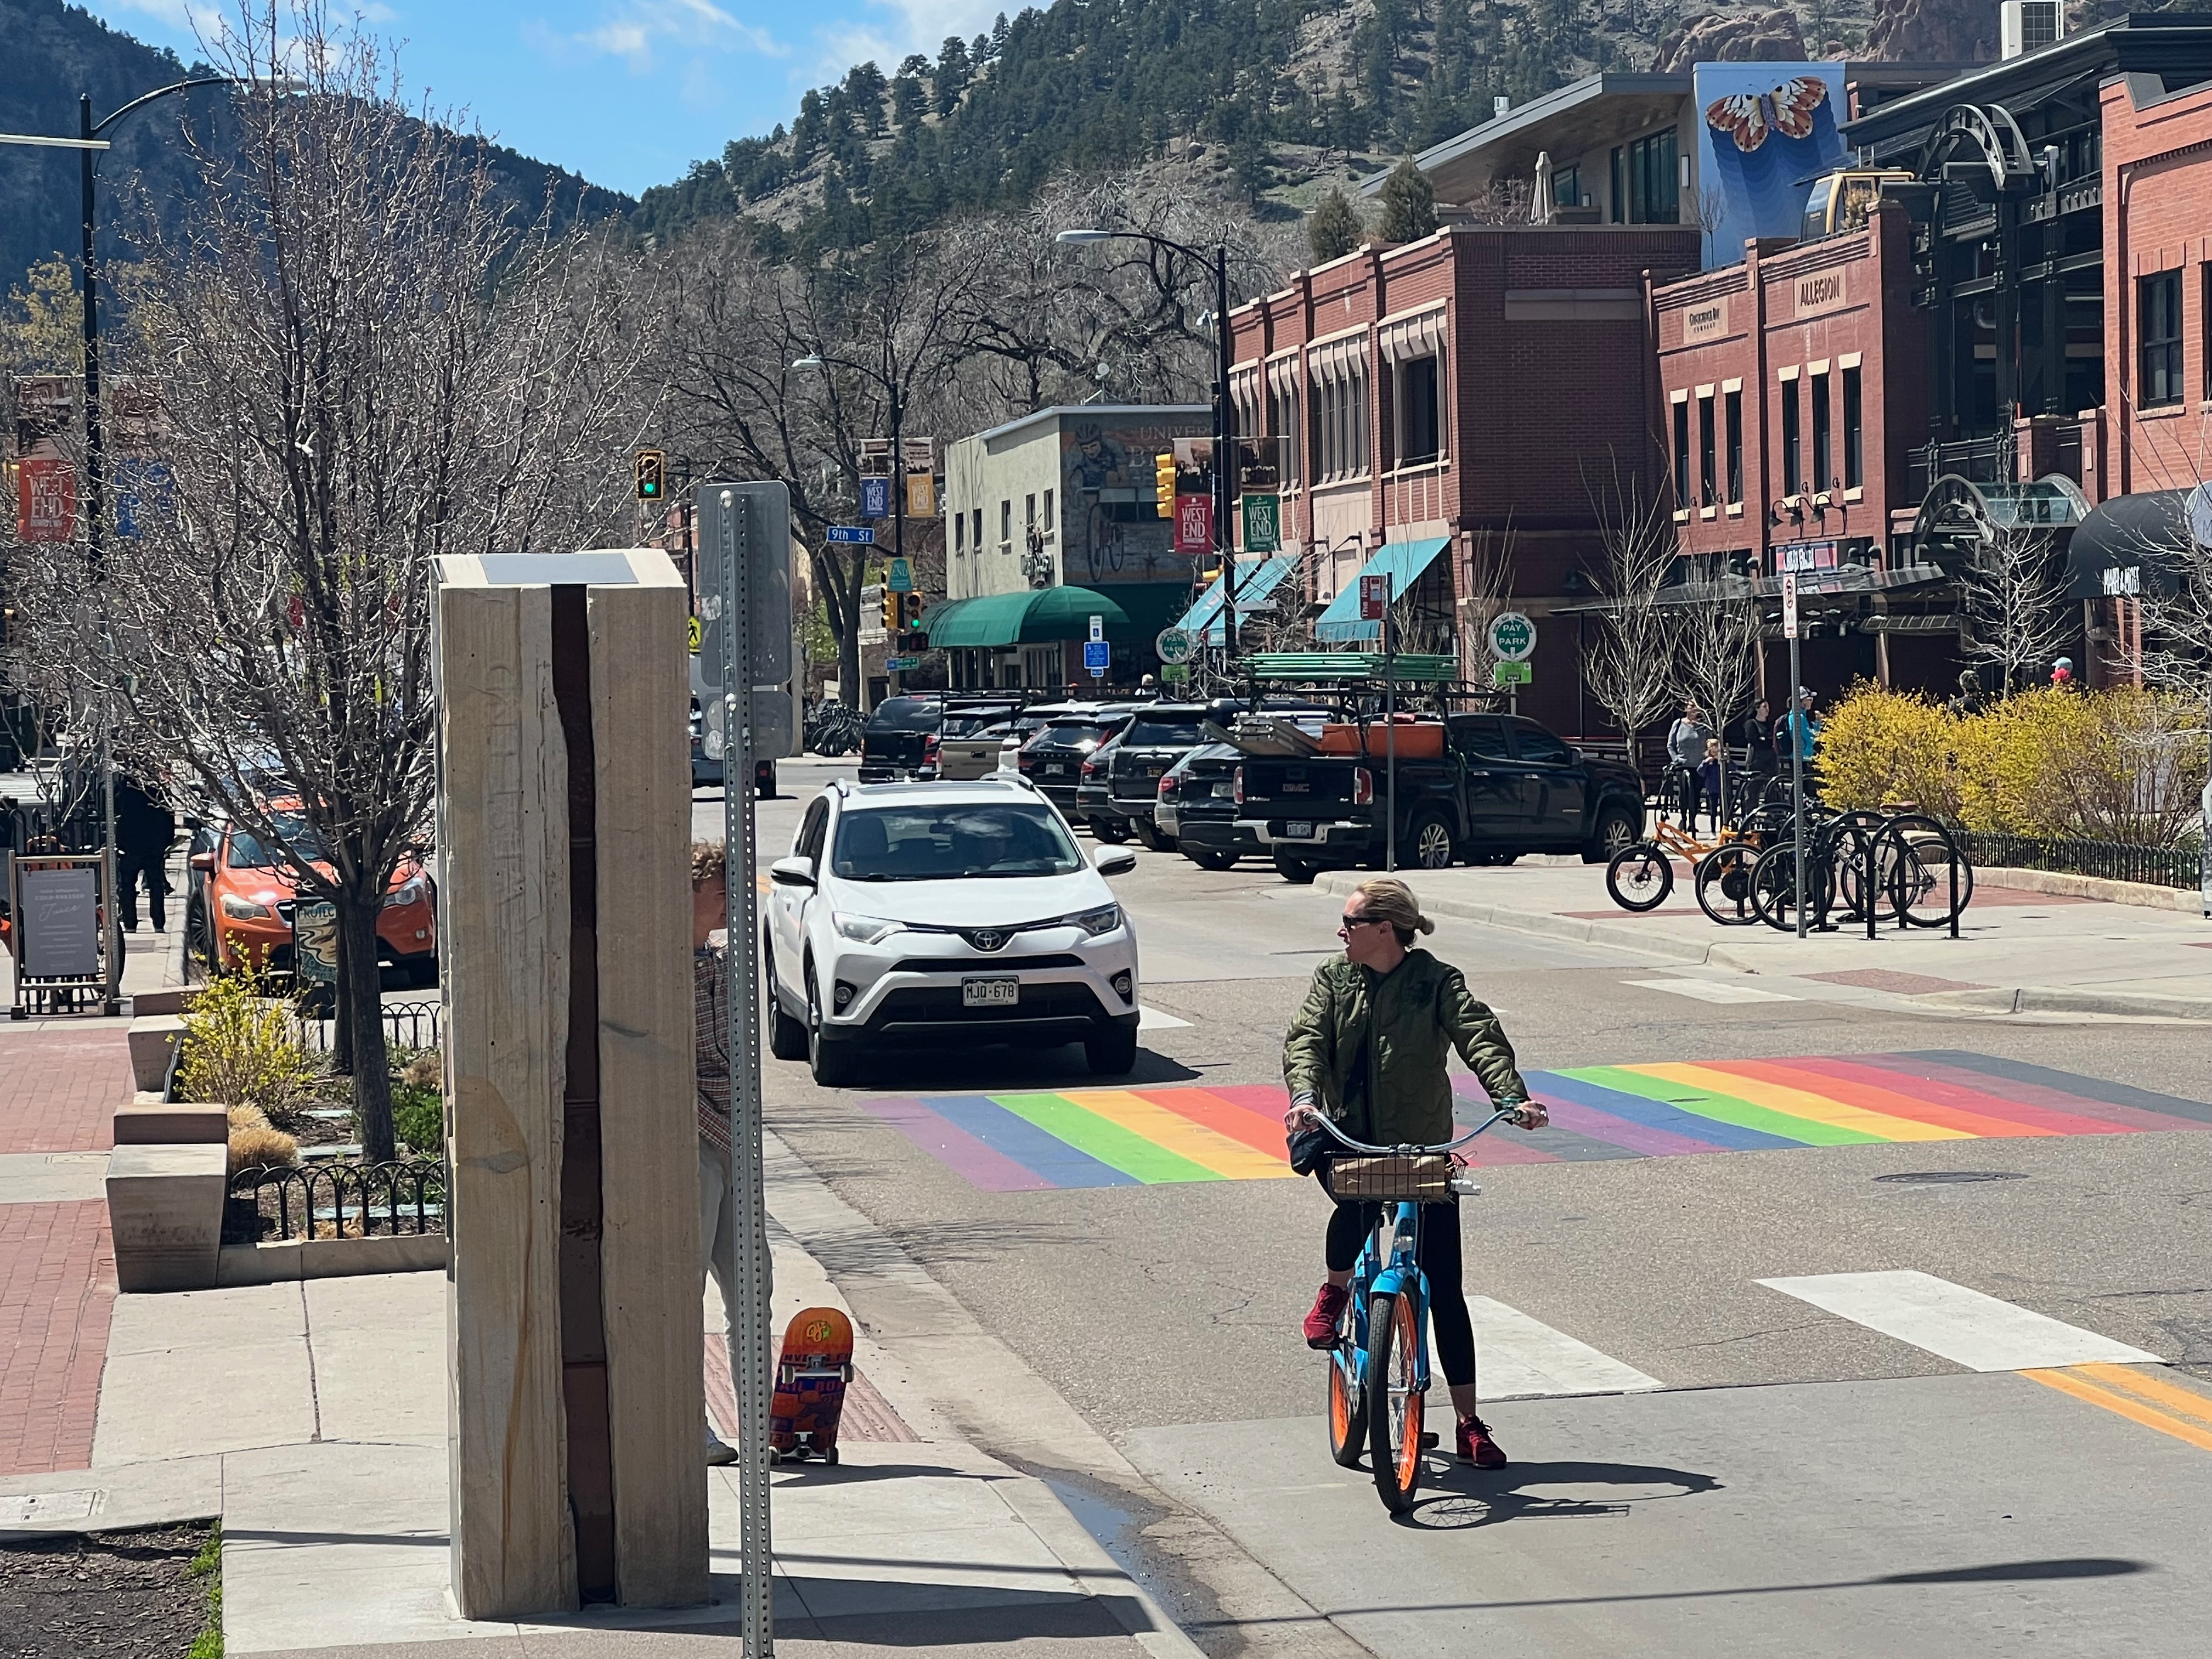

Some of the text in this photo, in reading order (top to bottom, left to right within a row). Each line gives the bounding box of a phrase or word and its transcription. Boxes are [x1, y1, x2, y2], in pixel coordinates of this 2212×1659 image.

[1800, 275, 1839, 307] ALLEGION
[866, 486, 884, 496] WEST
[867, 496, 884, 507] END
[913, 494, 929, 505] END
[1182, 507, 1206, 522] WEST
[1248, 506, 1272, 520] WEST
[831, 528, 870, 541] 9th St
[1183, 522, 1206, 538] END
[1250, 520, 1272, 536] END
[1498, 637, 1526, 646] PARK
